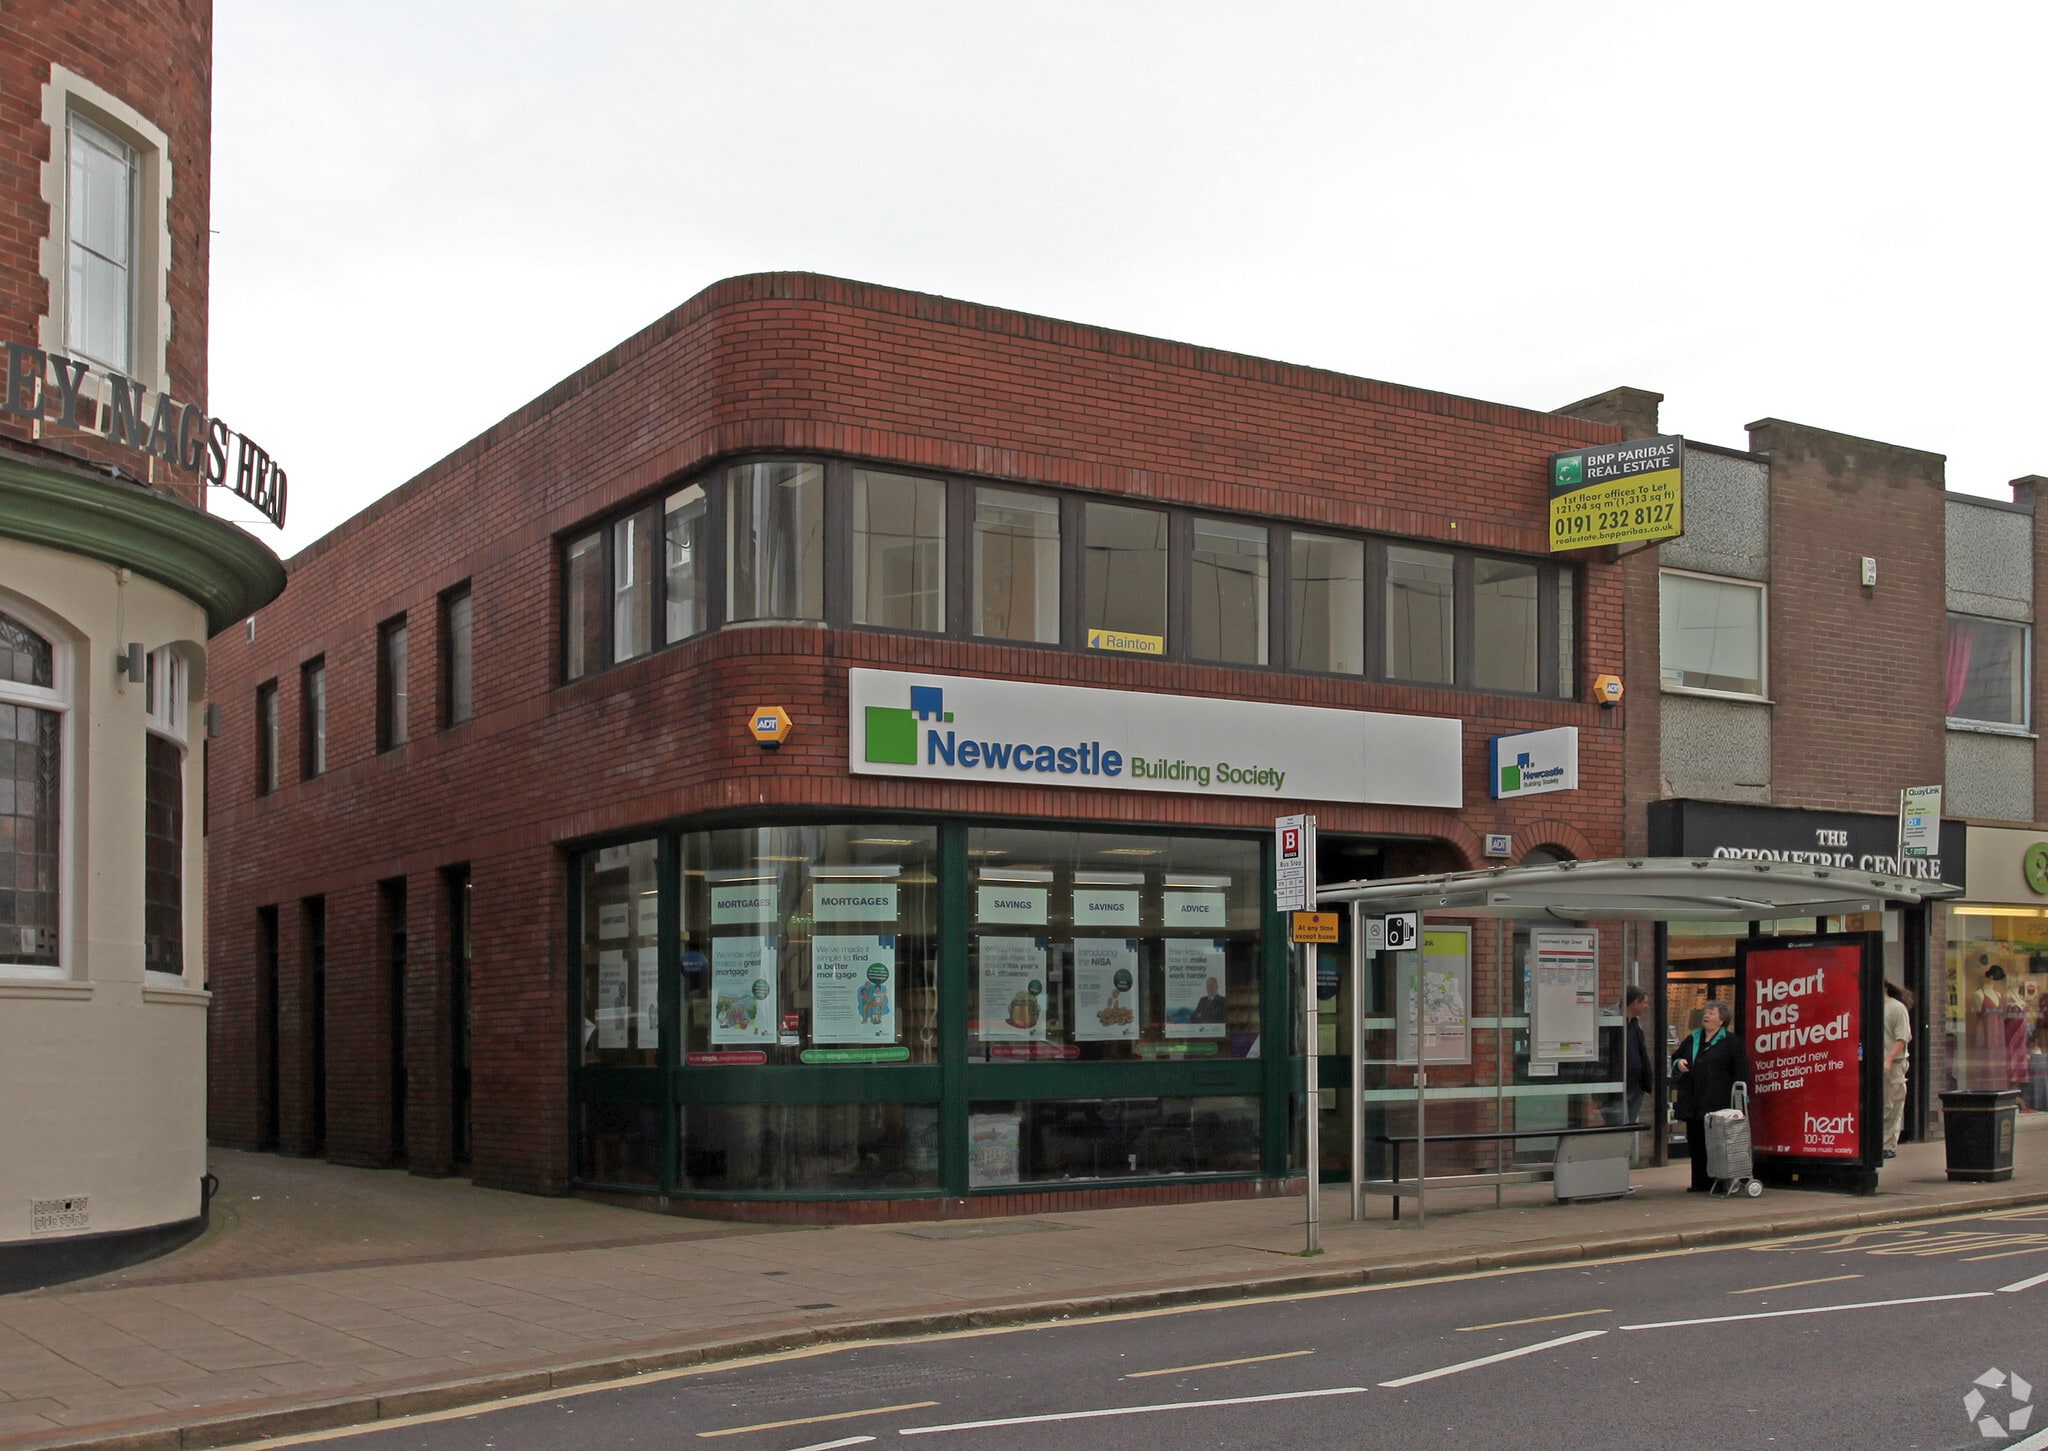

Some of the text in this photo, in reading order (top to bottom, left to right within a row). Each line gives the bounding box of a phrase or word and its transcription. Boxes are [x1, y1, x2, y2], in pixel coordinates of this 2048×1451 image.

[1588, 444, 1674, 466] BNP PARIBAS
[1588, 457, 1670, 478] REAL ESTATE
[234, 432, 287, 530] HEAD
[1564, 483, 1666, 504] 1st floor offices To Let
[1556, 501, 1587, 514] 121.94
[1590, 501, 1601, 509] sq
[1616, 494, 1647, 507] (1,313
[1650, 494, 1661, 503] sq
[1664, 491, 1675, 500] ft)
[1556, 503, 1675, 536] 0191 232 8127
[1556, 523, 1673, 545] realestate.bnpparibas.co.uk
[1107, 635, 1155, 651] Rainton
[757, 719, 777, 729] ADT
[927, 729, 1123, 776] Newcastle
[1131, 756, 1285, 792] Building Society
[1523, 766, 1564, 780] Newcastle
[1523, 780, 1542, 788] Building
[1908, 787, 1940, 796] QuayLink
[1286, 832, 1296, 849] B
[1816, 829, 1848, 846] THE
[1860, 854, 1942, 880] CENTRE
[717, 899, 771, 909] MORTGAGES
[821, 898, 889, 906] MORTGAGES
[994, 900, 1032, 909] SAVINGS
[1088, 903, 1125, 911] SAVINGS
[1181, 905, 1209, 913] ADVICE
[816, 954, 842, 962] simple
[852, 953, 868, 961] find
[842, 945, 863, 953] made
[743, 959, 761, 968] great
[1091, 958, 1111, 966] NISA
[715, 968, 749, 977] mortgage
[1756, 968, 1824, 1004] Heart
[1756, 1004, 1799, 1029] has
[1755, 1013, 1849, 1053] arrived!
[1755, 1051, 1829, 1070] Your brand new
[1755, 1060, 1844, 1082] radio station for the
[1755, 1077, 1805, 1094] North East
[1804, 1112, 1854, 1134] heart
[1804, 1134, 1835, 1144] 100-102
